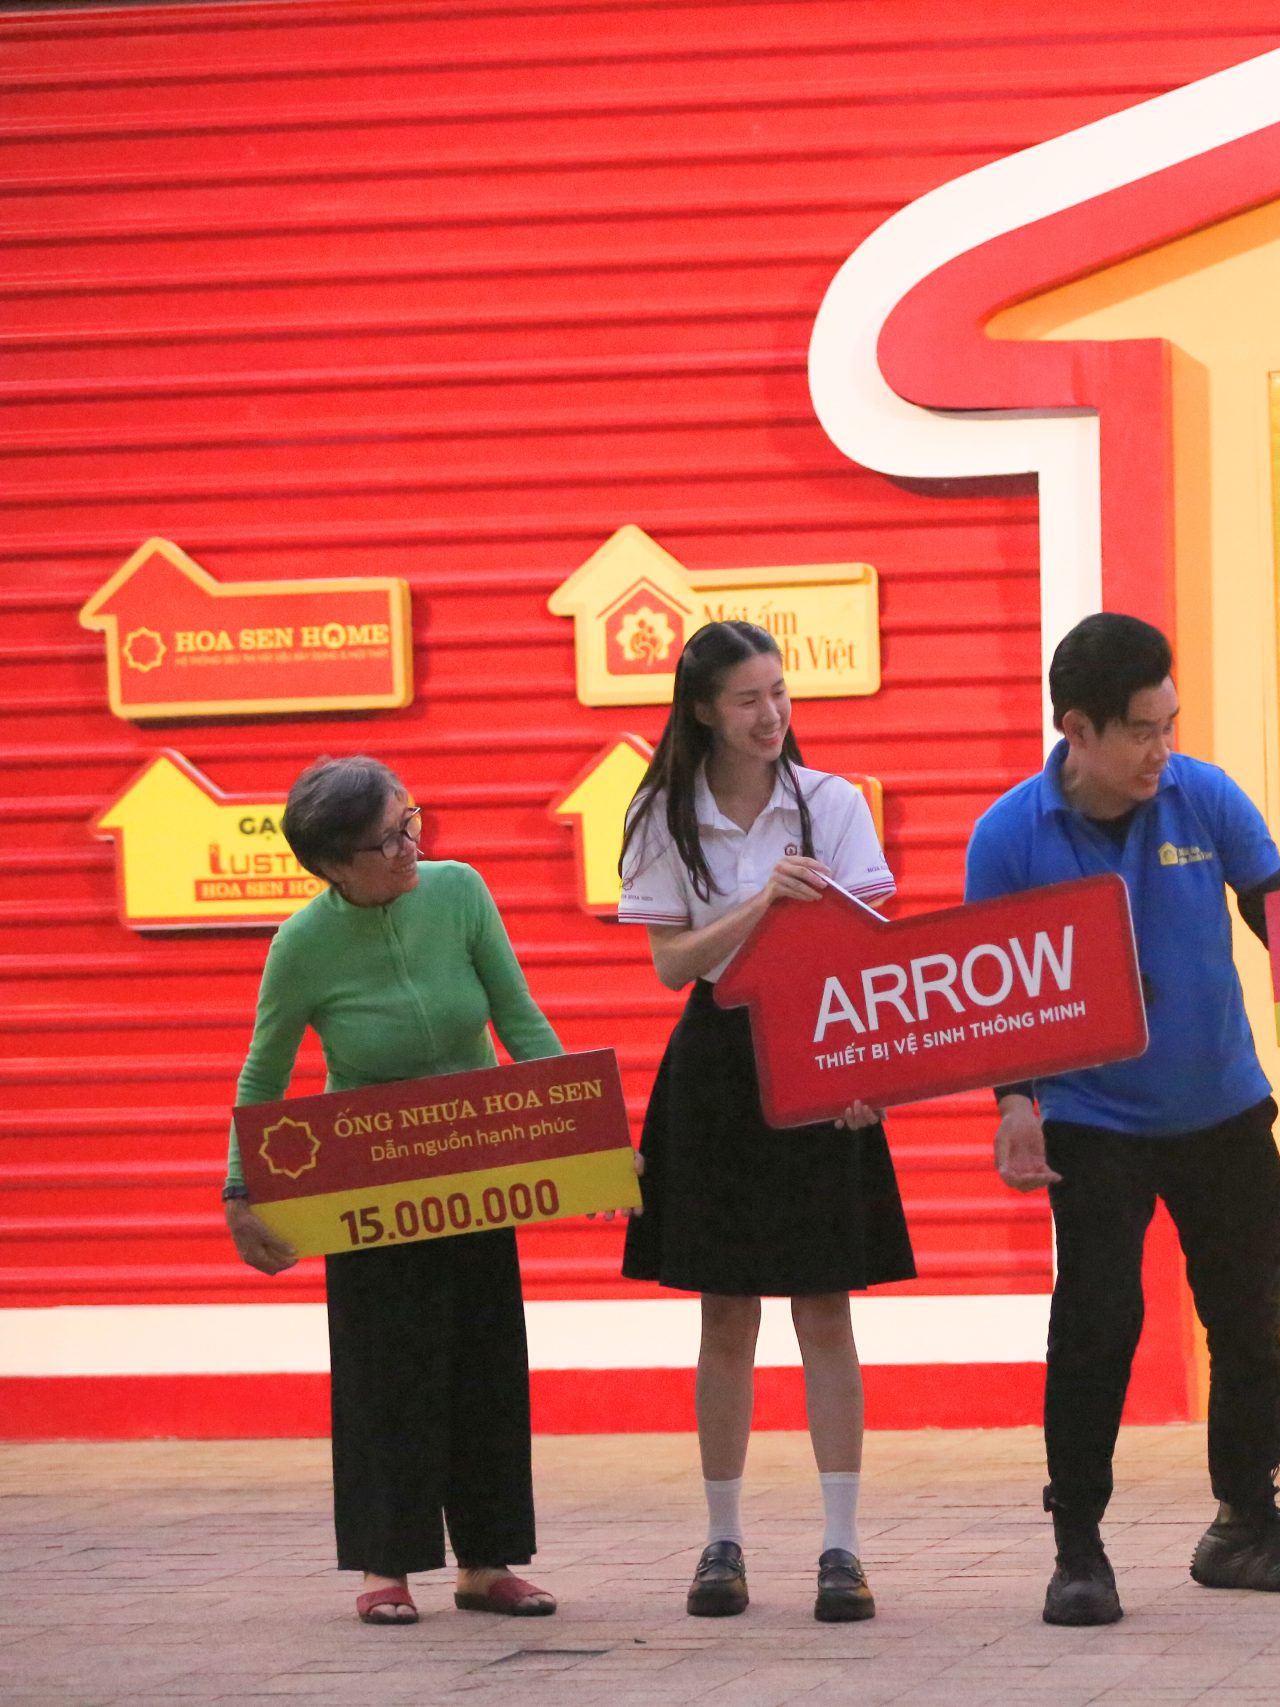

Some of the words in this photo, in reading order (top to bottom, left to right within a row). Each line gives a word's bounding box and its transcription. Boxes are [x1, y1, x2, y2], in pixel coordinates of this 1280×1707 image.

[175, 630, 234, 652] HOA
[239, 627, 294, 650] SEN
[302, 622, 390, 649] HOME
[806, 635, 858, 675] Việt
[238, 817, 284, 840] GẠ
[201, 882, 242, 899] HOA
[246, 881, 284, 898] SEN
[289, 878, 324, 898] HO
[812, 925, 1075, 1043] ARROW
[814, 1042, 865, 1071] THIẾT
[871, 1041, 890, 1060] BỊ
[893, 1034, 918, 1056] VỆ
[923, 1027, 965, 1049] SINH
[969, 1014, 1035, 1039] THÔNG
[1039, 1000, 1087, 1024] MINH
[333, 1108, 394, 1138] ỐNG
[398, 1098, 477, 1128] NHỰA
[483, 1089, 543, 1115] HOA
[547, 1079, 603, 1105] SEN
[370, 1139, 409, 1162] Dẫn
[413, 1130, 473, 1158] nguồn
[476, 1123, 525, 1147] hạnh
[529, 1117, 577, 1141] phúc
[339, 1178, 560, 1246] 15.000.000
